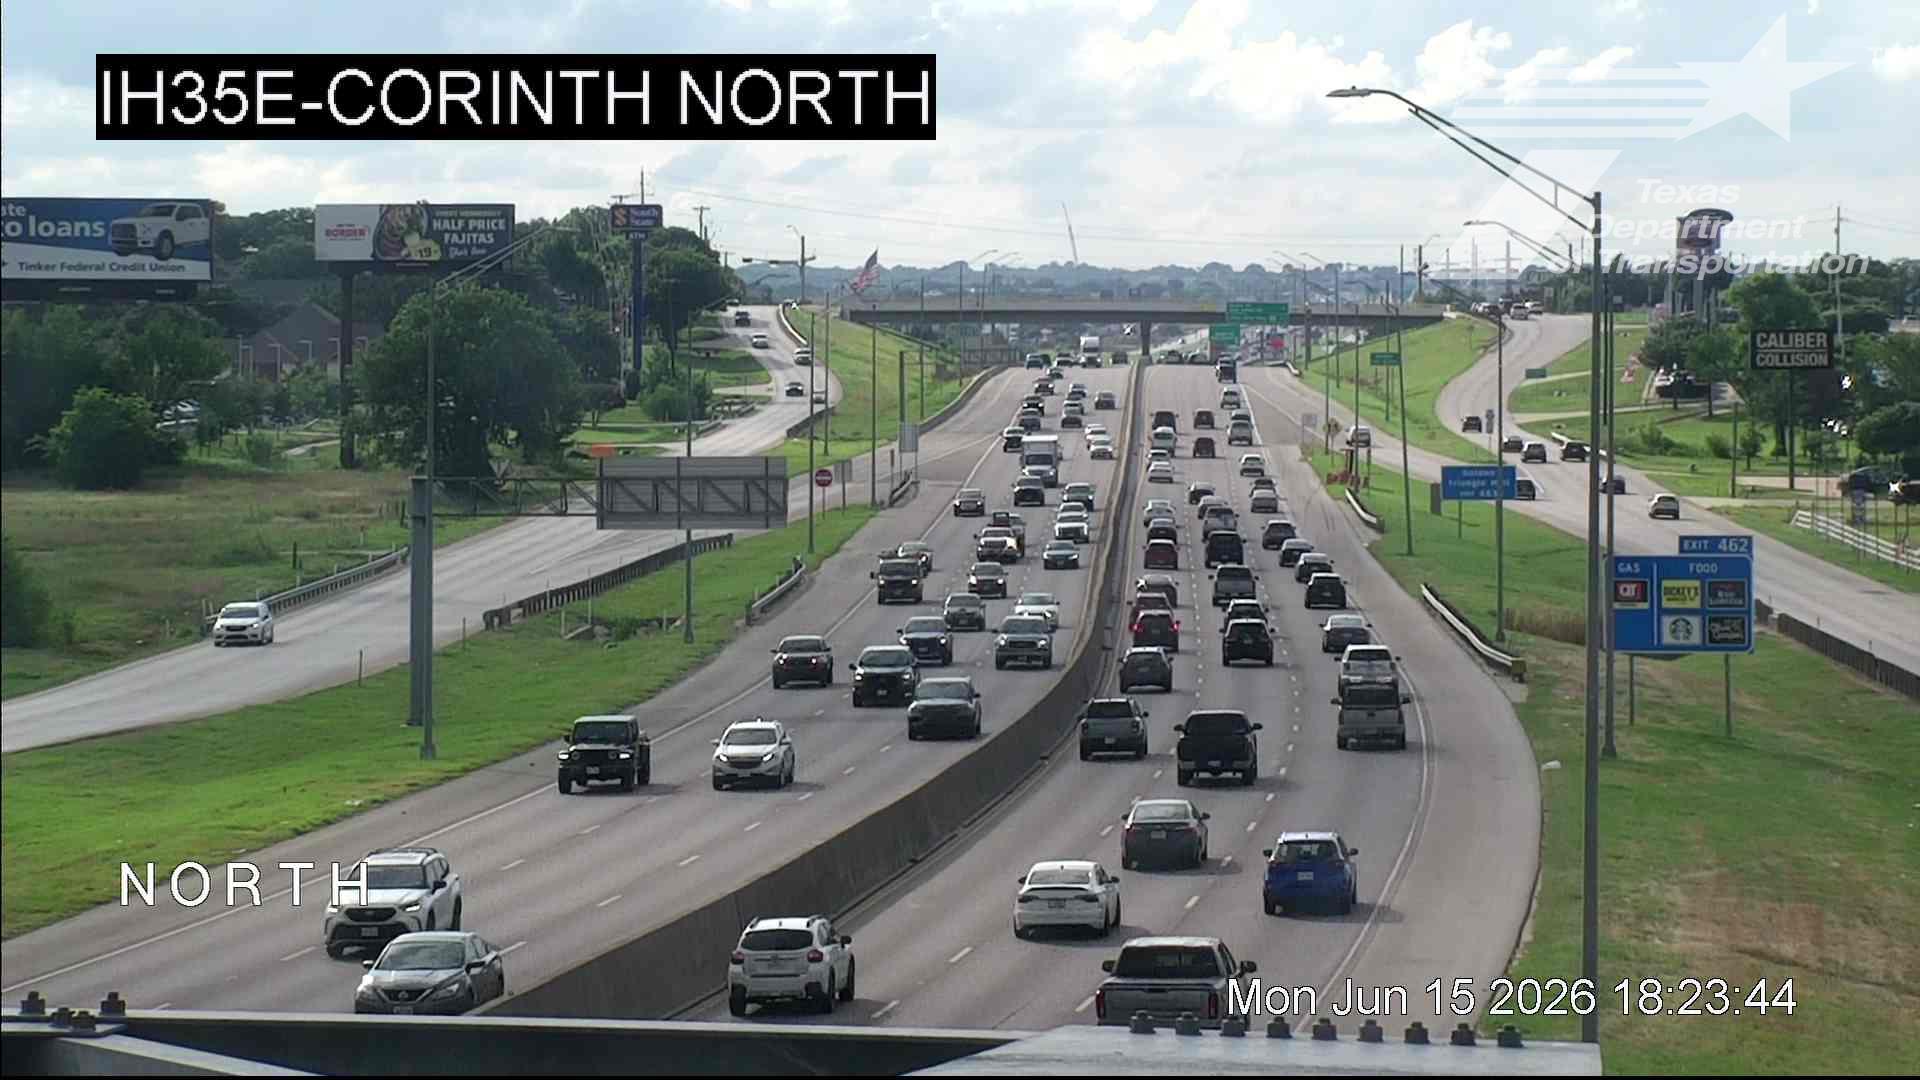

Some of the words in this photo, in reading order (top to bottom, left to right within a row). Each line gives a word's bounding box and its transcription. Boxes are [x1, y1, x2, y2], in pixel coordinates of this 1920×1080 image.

[28, 215, 105, 237] loans
[433, 219, 462, 230] HALF
[468, 219, 506, 230] PRICE
[444, 232, 495, 244] FAJITAS
[18, 262, 55, 272] Tinker
[61, 262, 104, 272] Federal
[109, 262, 145, 272] Credit
[150, 262, 186, 272] Union
[1756, 332, 1828, 348] CALIBER
[1756, 353, 1829, 367] COLLISION
[1683, 540, 1709, 550] EXIT
[1718, 539, 1749, 552] 462
[1617, 563, 1641, 573] GAS
[1688, 563, 1719, 573] FOOD
